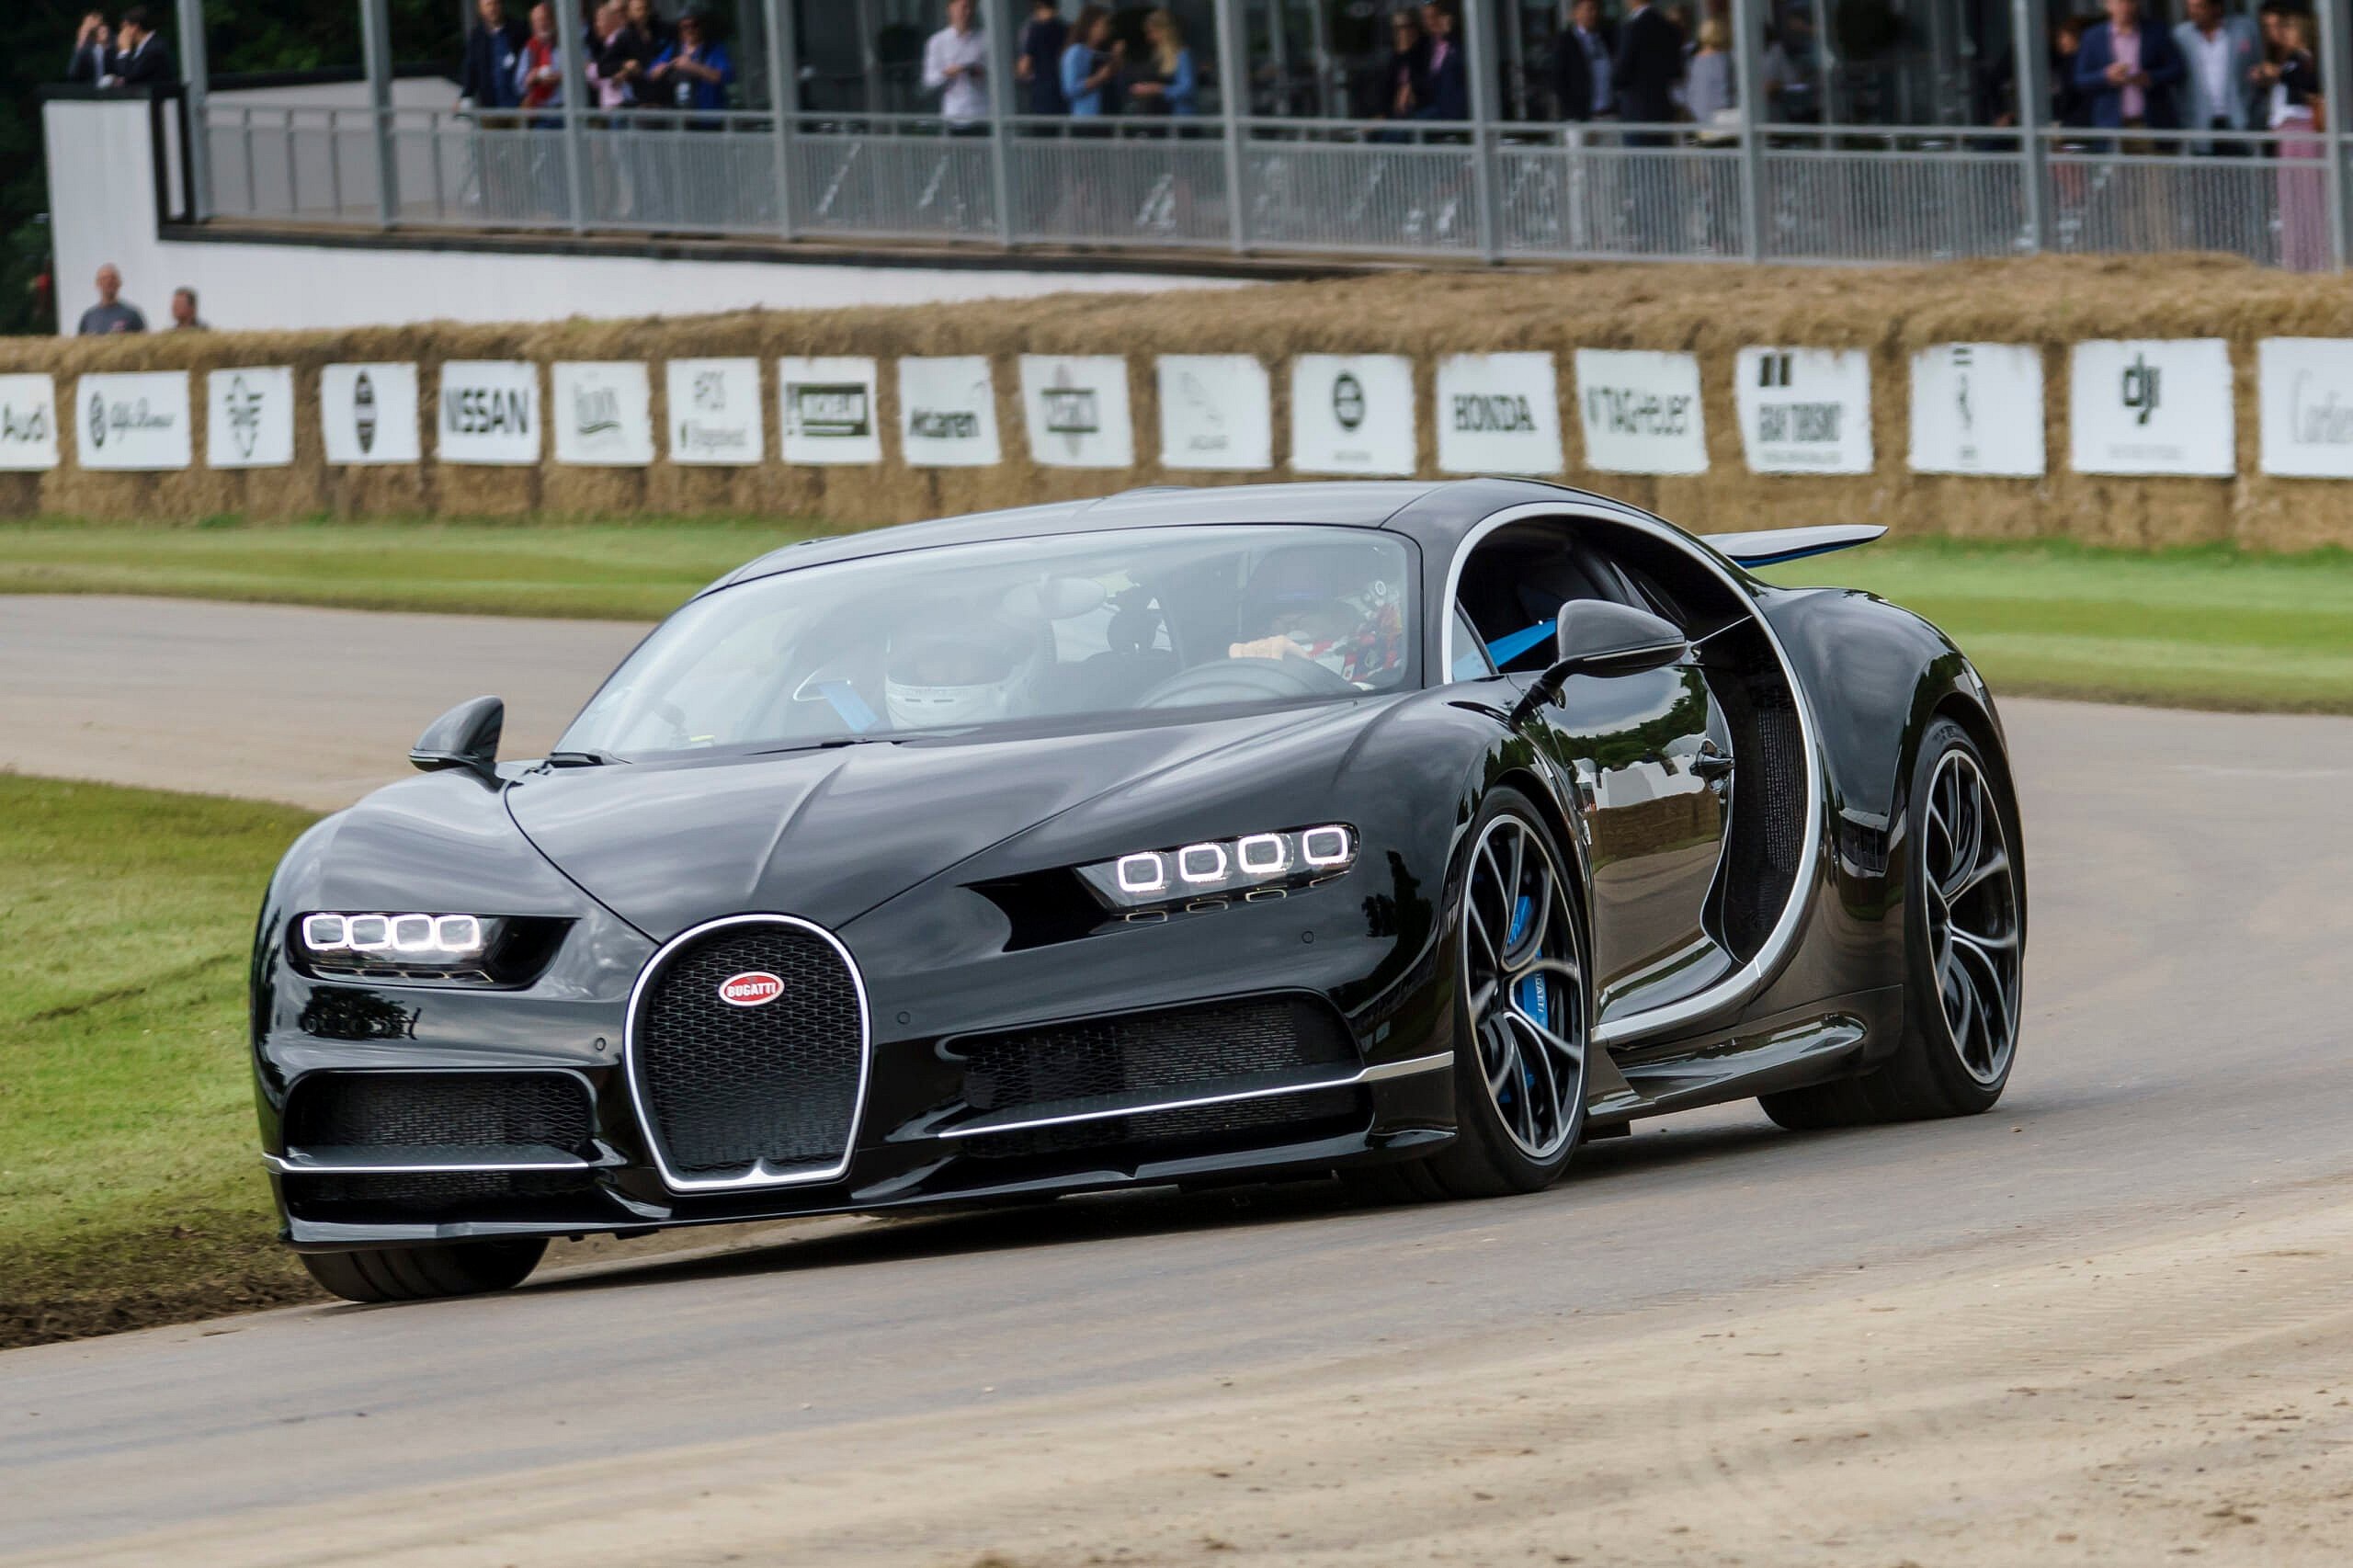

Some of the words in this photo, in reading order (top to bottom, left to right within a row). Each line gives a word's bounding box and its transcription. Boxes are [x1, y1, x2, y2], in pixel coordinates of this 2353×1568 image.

[445, 387, 529, 435] NISSAN
[1453, 394, 1536, 431] HONDA
[726, 983, 777, 997] BUGATTI
